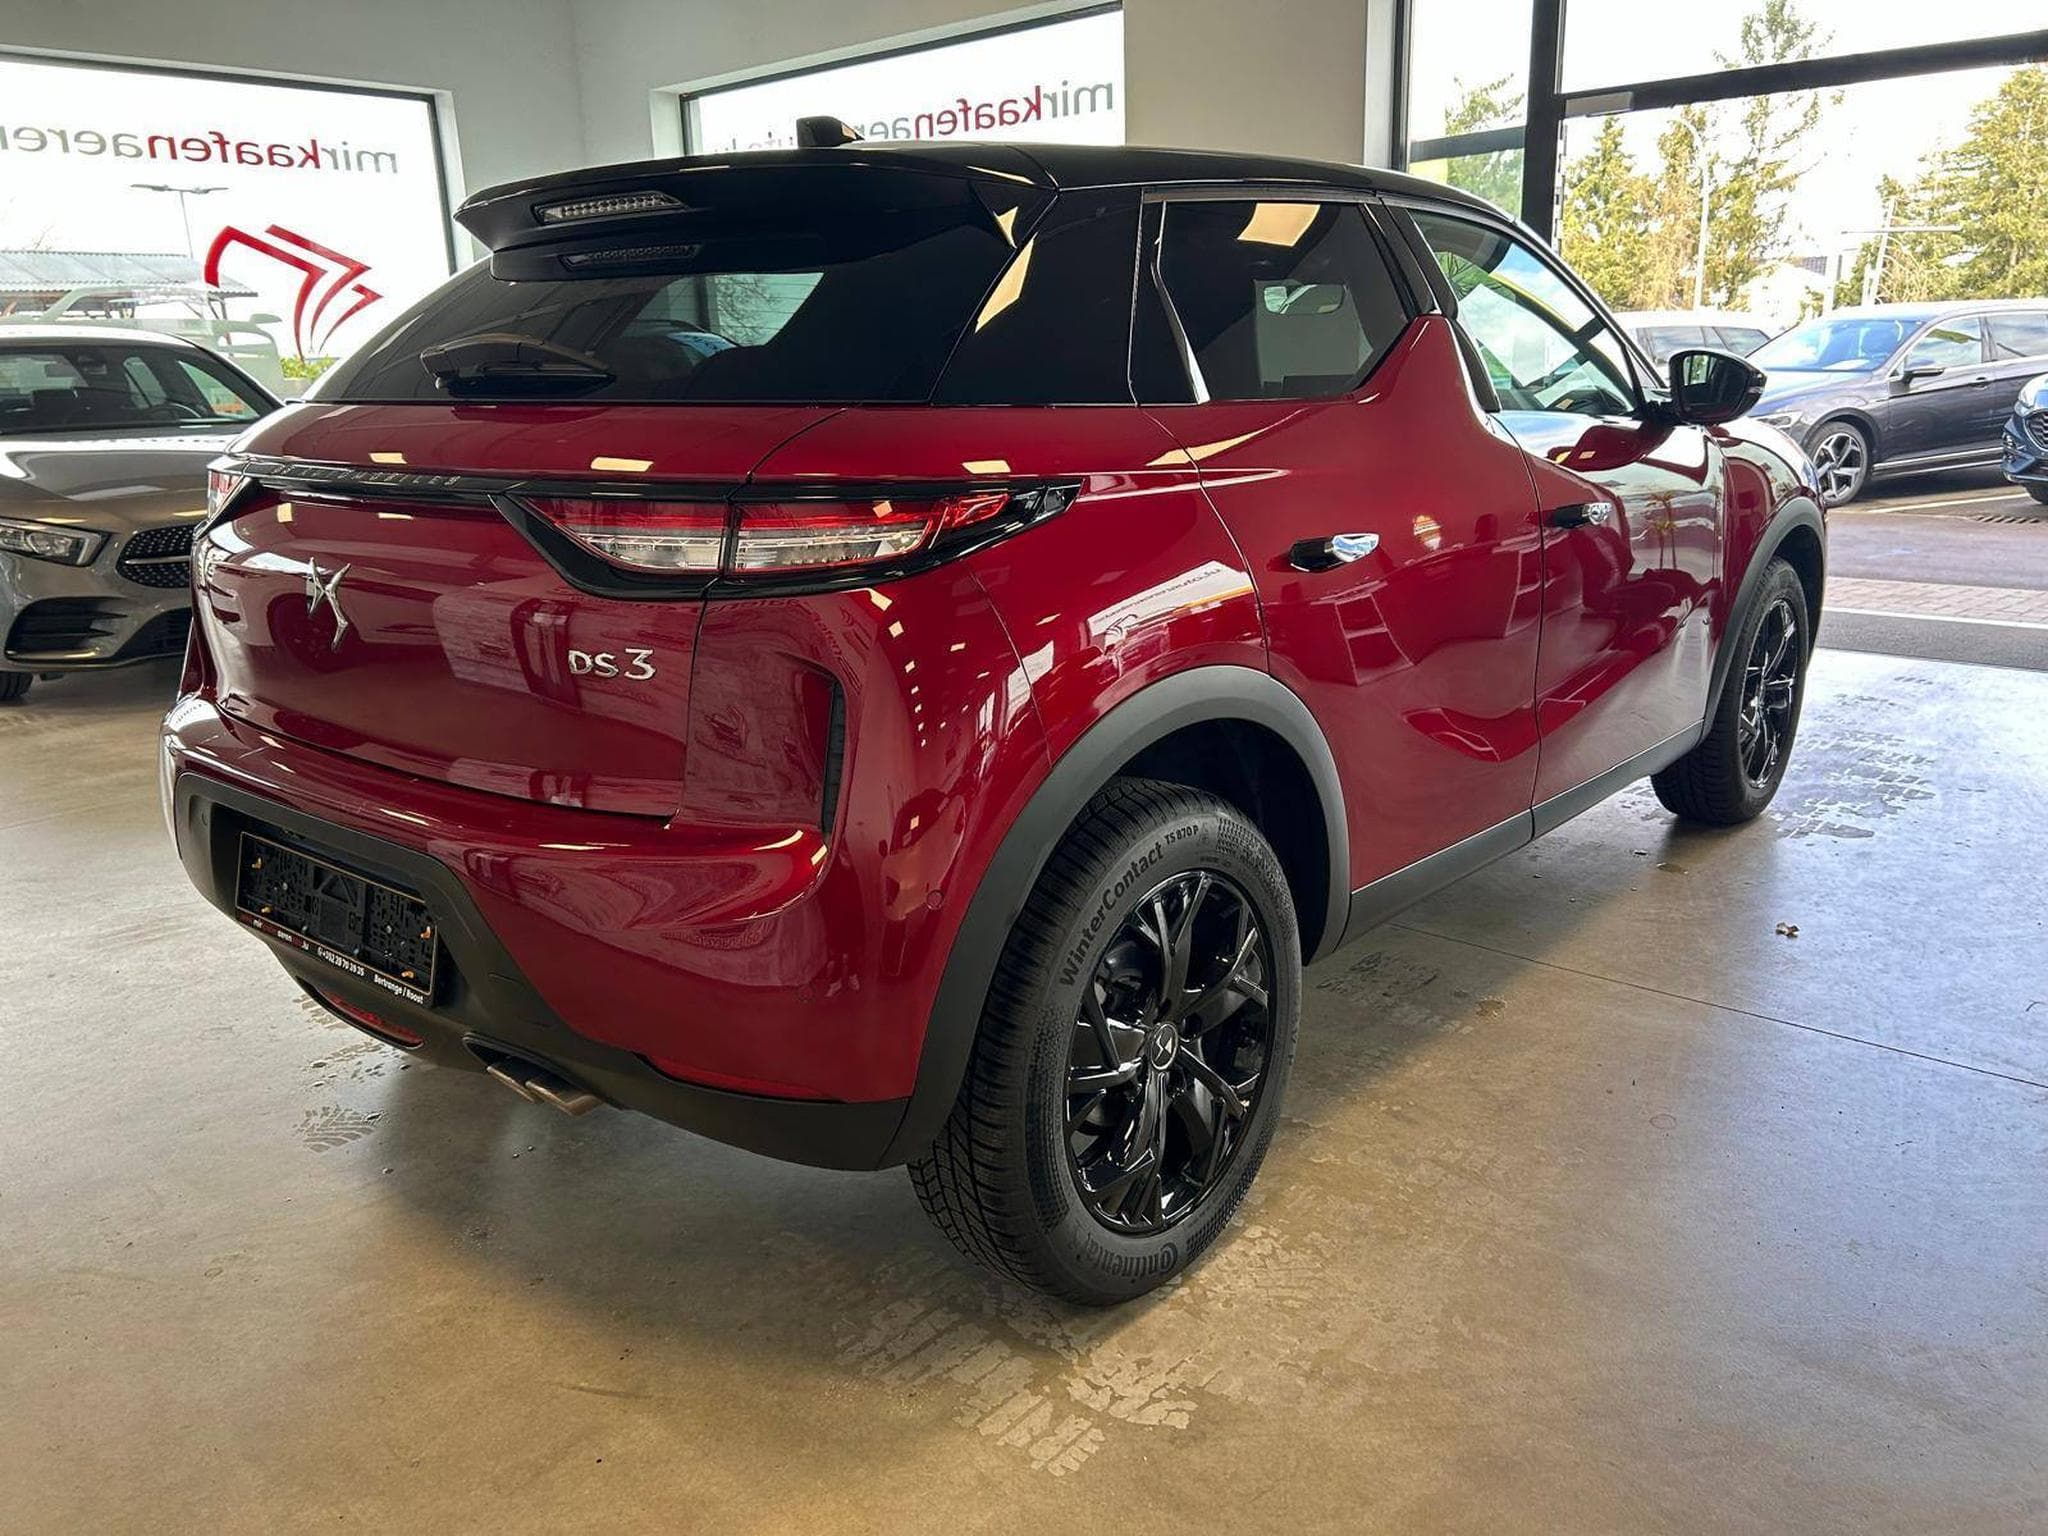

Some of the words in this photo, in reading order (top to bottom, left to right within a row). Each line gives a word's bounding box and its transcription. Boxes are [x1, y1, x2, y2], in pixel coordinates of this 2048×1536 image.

[568, 649, 619, 678] DS
[624, 647, 657, 680] 3
[1060, 841, 1164, 986] WinterContact
